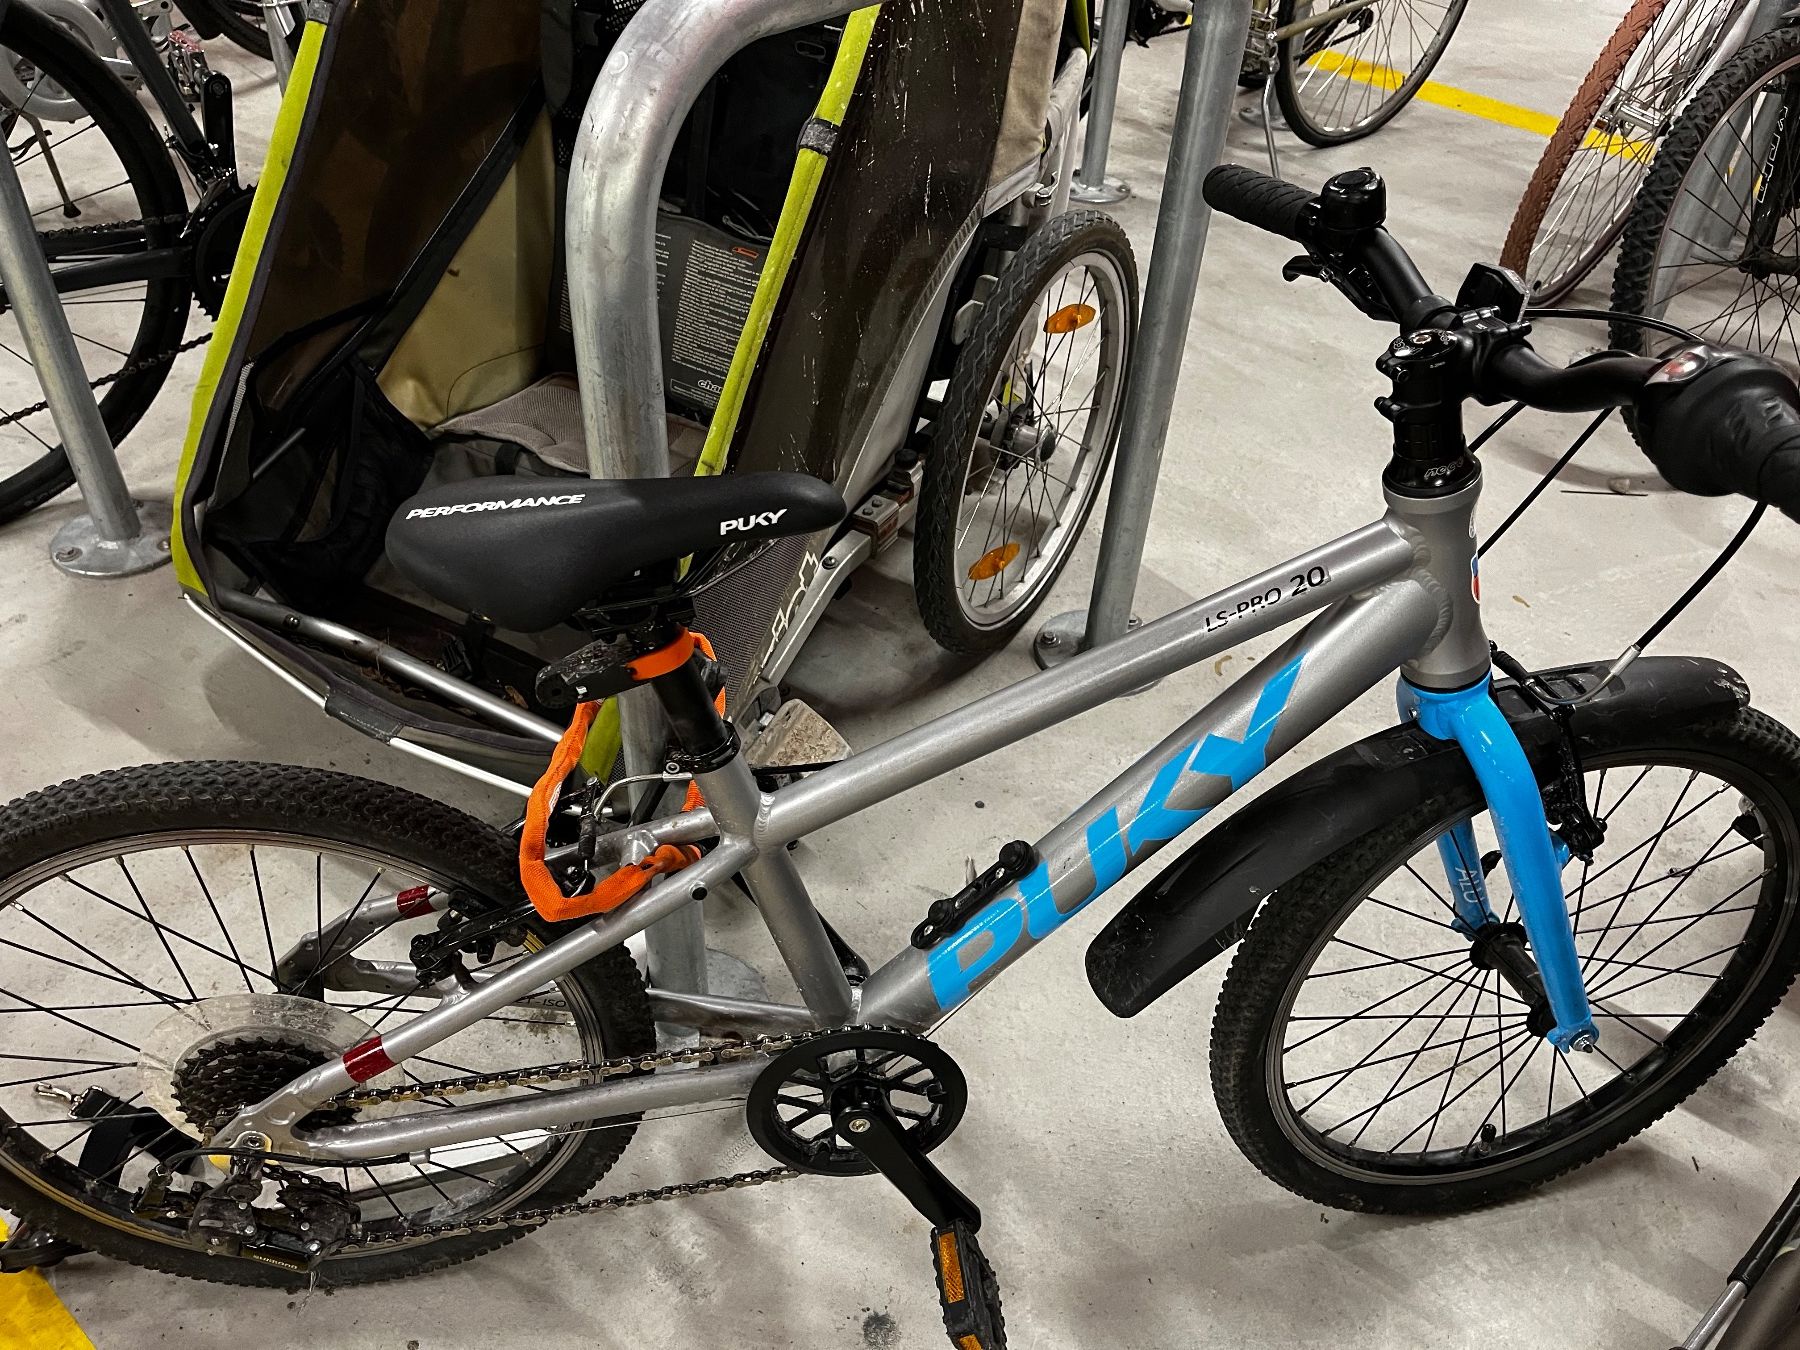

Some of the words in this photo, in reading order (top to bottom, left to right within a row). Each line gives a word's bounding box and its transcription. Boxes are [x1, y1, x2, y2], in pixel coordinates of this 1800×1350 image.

[405, 493, 587, 520] PERFORMANCE
[718, 508, 788, 536] PUKY
[1205, 587, 1282, 633] LS-PRO
[1289, 565, 1326, 598] 20
[926, 648, 1309, 1012] PUKY
[1455, 866, 1486, 904] ALU
